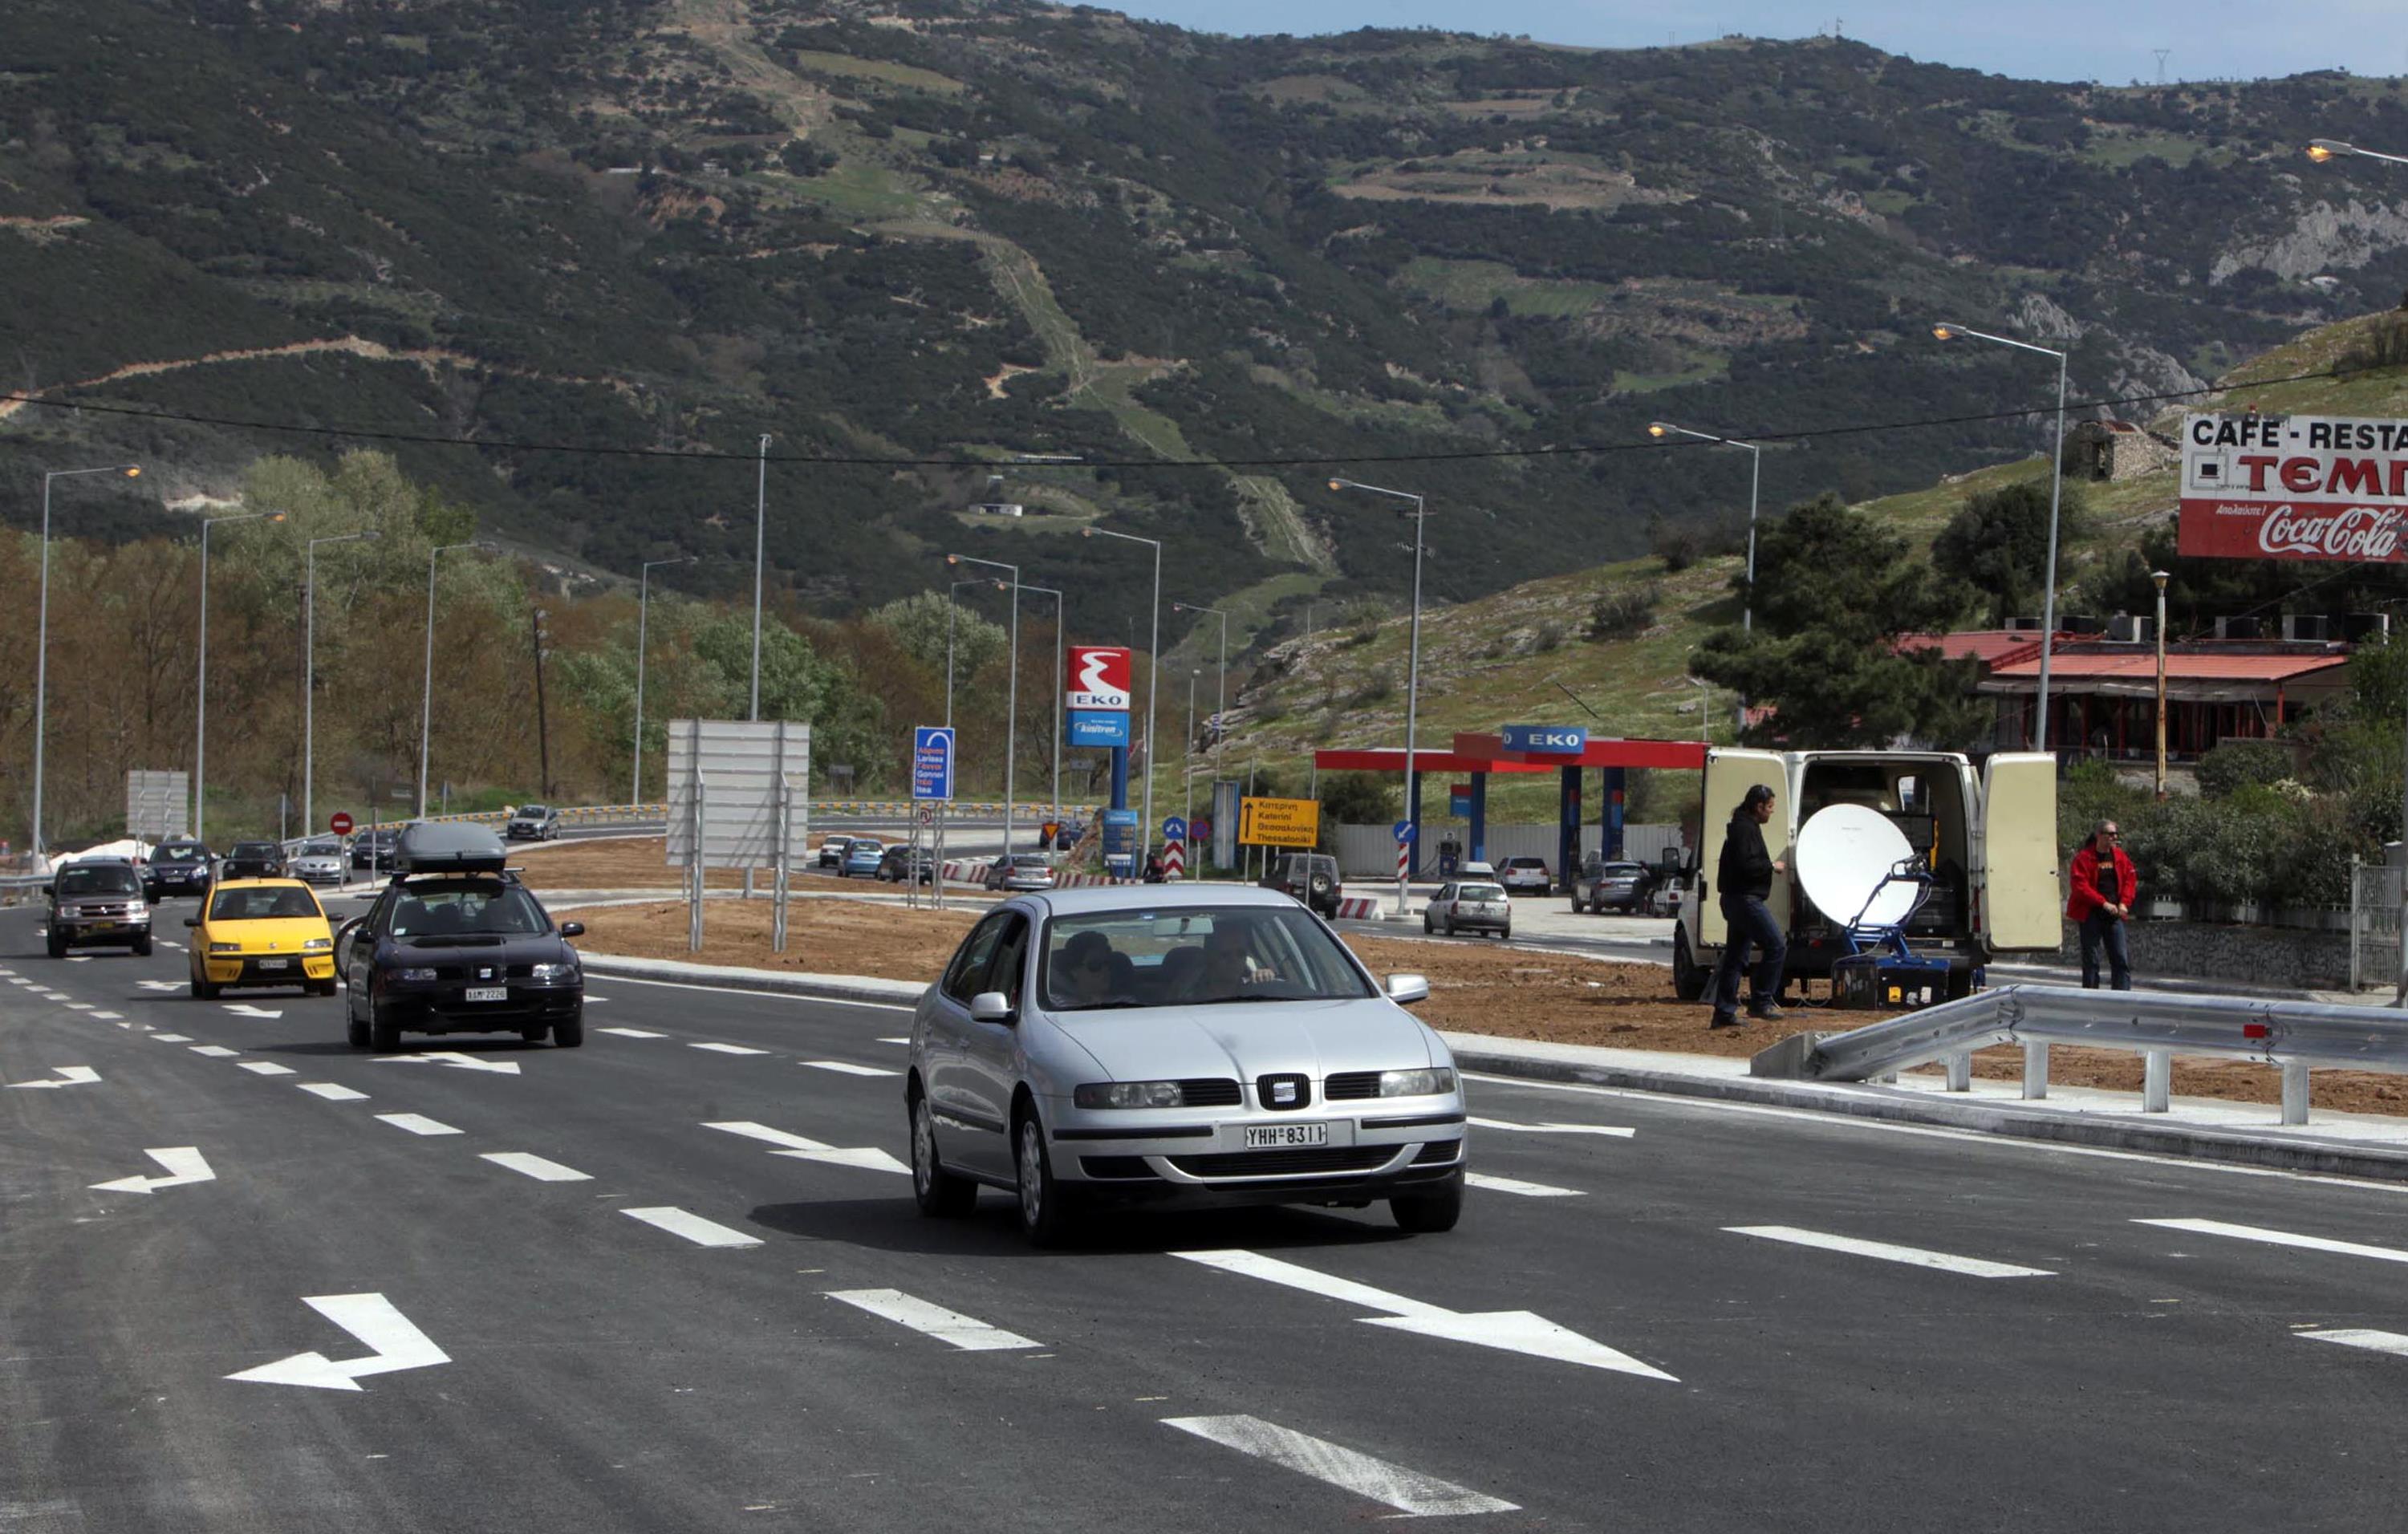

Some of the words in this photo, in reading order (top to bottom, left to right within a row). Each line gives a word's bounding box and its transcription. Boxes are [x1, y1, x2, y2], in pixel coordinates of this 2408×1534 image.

[2192, 420, 2280, 447] CAFE
[2309, 422, 2408, 452] RESTA
[2259, 505, 2402, 557] Coca-Cola
[1076, 695, 1122, 705] EKO
[1529, 733, 1579, 747] EKO
[1258, 812, 1292, 820] Katerini
